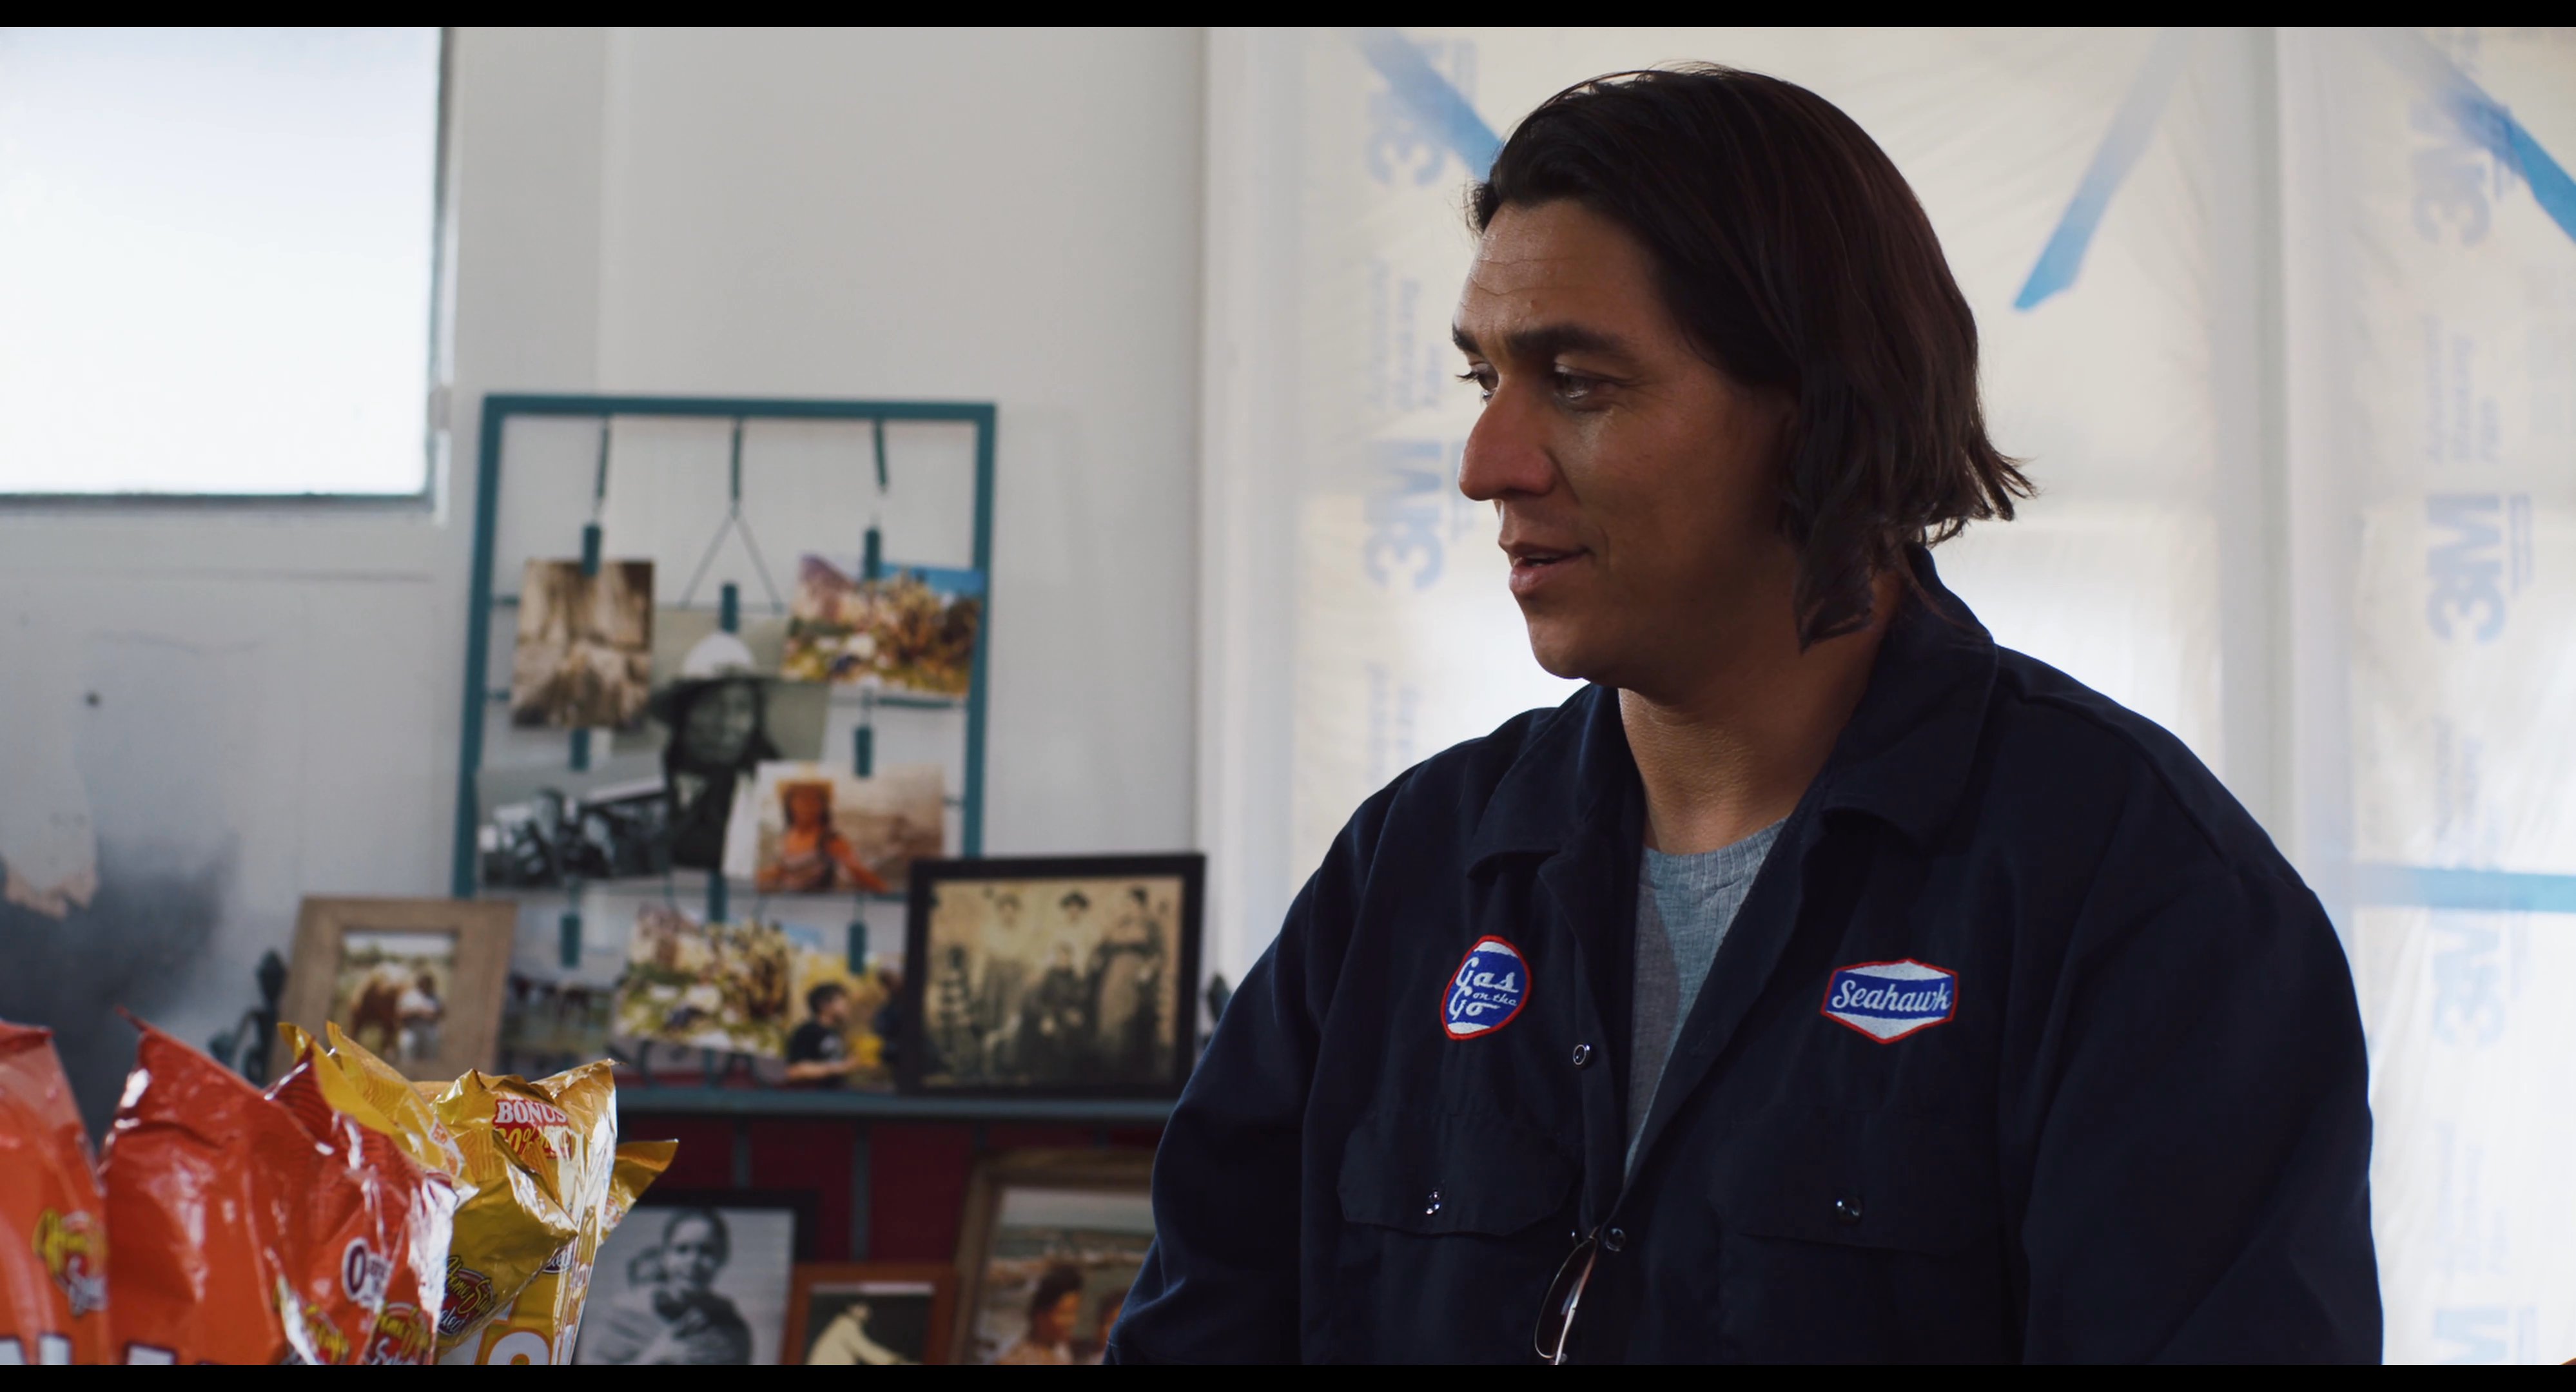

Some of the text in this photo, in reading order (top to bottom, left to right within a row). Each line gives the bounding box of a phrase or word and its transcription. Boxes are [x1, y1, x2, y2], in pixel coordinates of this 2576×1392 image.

[1364, 440, 1444, 588] 3M
[2425, 494, 2506, 644] 3M
[1456, 957, 1519, 993] Gas
[1449, 986, 1501, 1021] Go
[1492, 993, 1517, 1007] the
[1831, 980, 1951, 1012] Seahawk
[495, 1101, 568, 1124] BONUS
